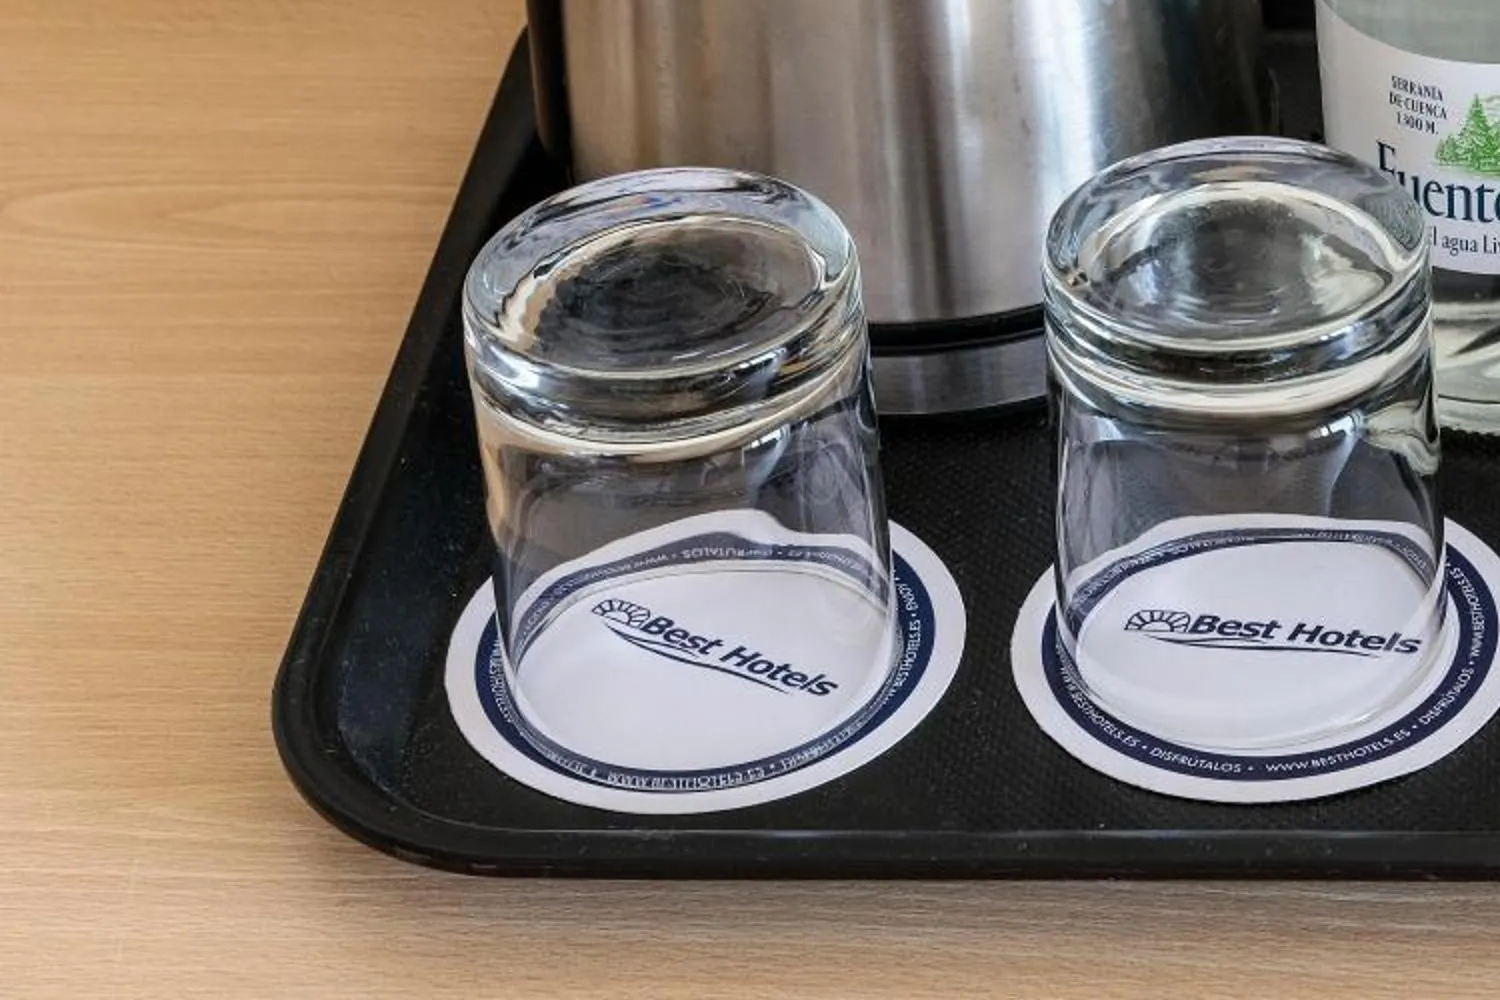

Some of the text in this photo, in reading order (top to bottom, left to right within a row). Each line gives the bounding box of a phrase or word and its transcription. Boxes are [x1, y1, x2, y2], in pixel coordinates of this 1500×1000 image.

[1389, 91, 1447, 120] DE CUENCA
[1441, 234, 1479, 256] agua
[1189, 613, 1423, 655] Best Hotels
[643, 616, 840, 697] Best Hotels
